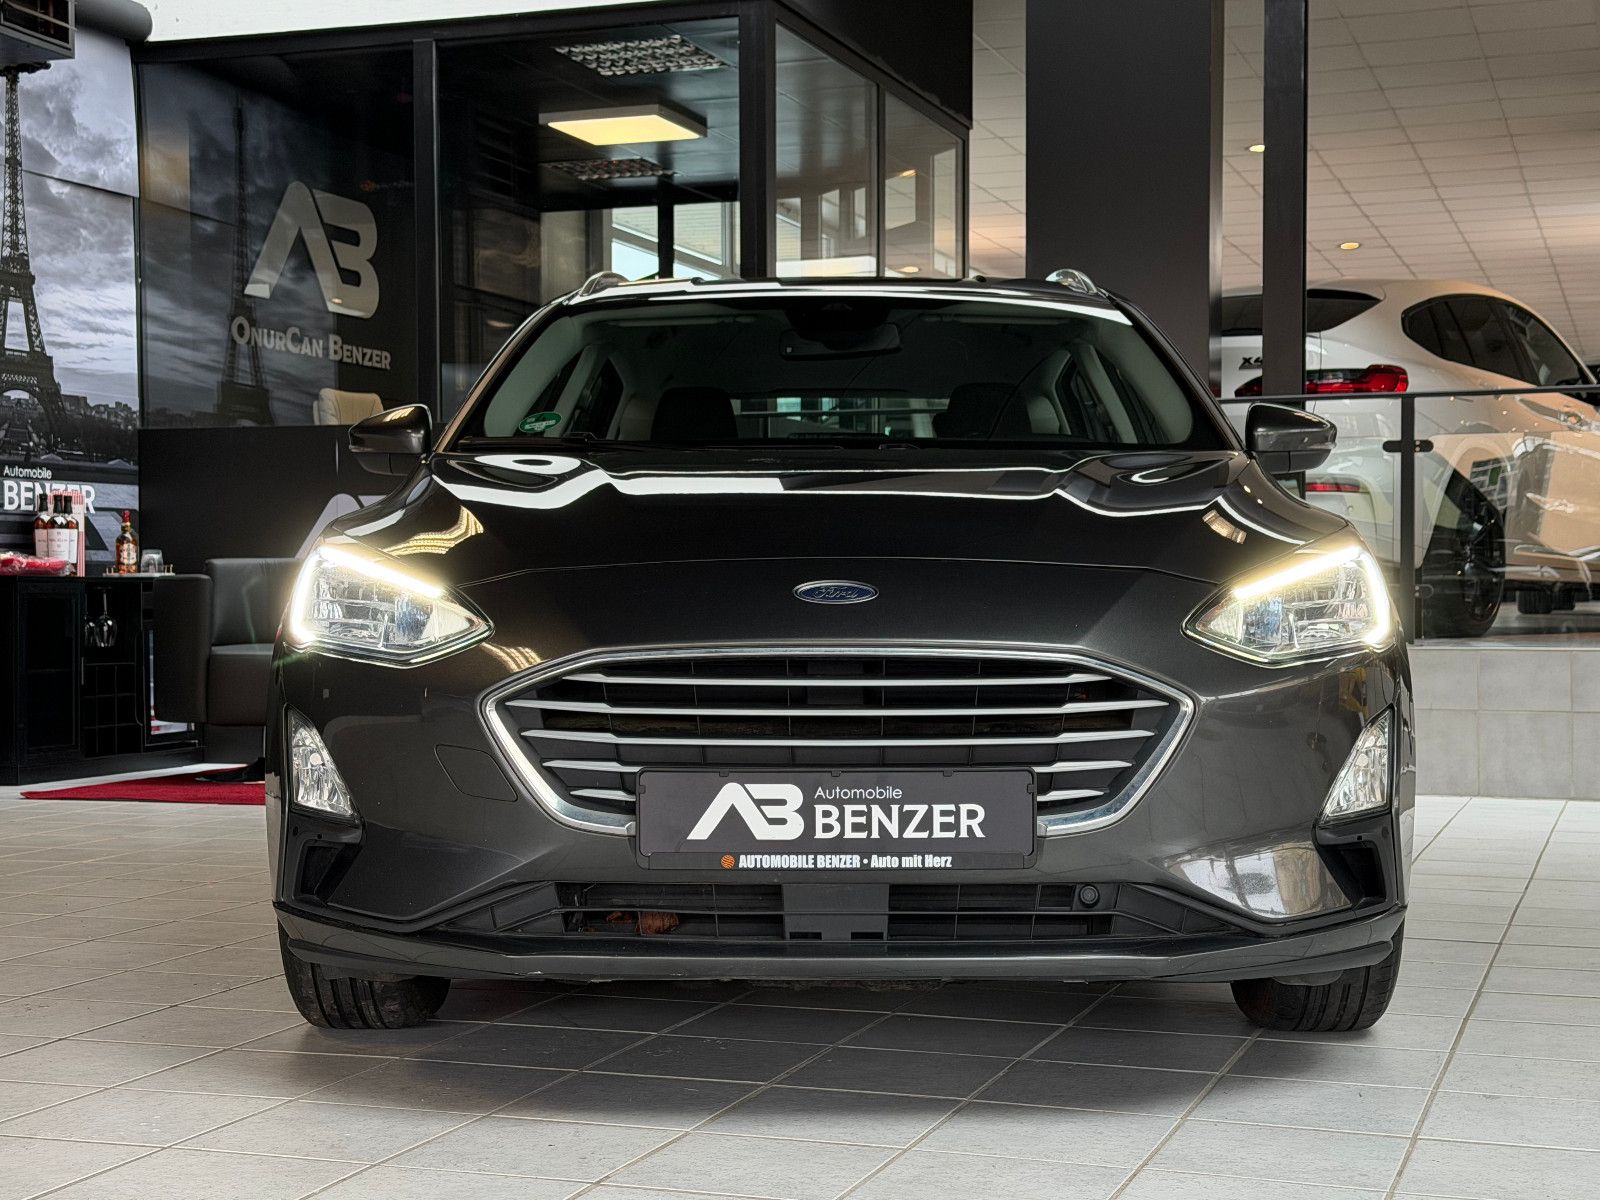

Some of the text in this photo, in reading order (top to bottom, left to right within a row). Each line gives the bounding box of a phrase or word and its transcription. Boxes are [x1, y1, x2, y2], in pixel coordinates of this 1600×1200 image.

[3, 465, 52, 479] Automobile
[814, 785, 902, 799] Automobile
[813, 803, 986, 839] BENZER
[738, 854, 953, 869] AUTOMOBILE BENZER Auto mit Herz
